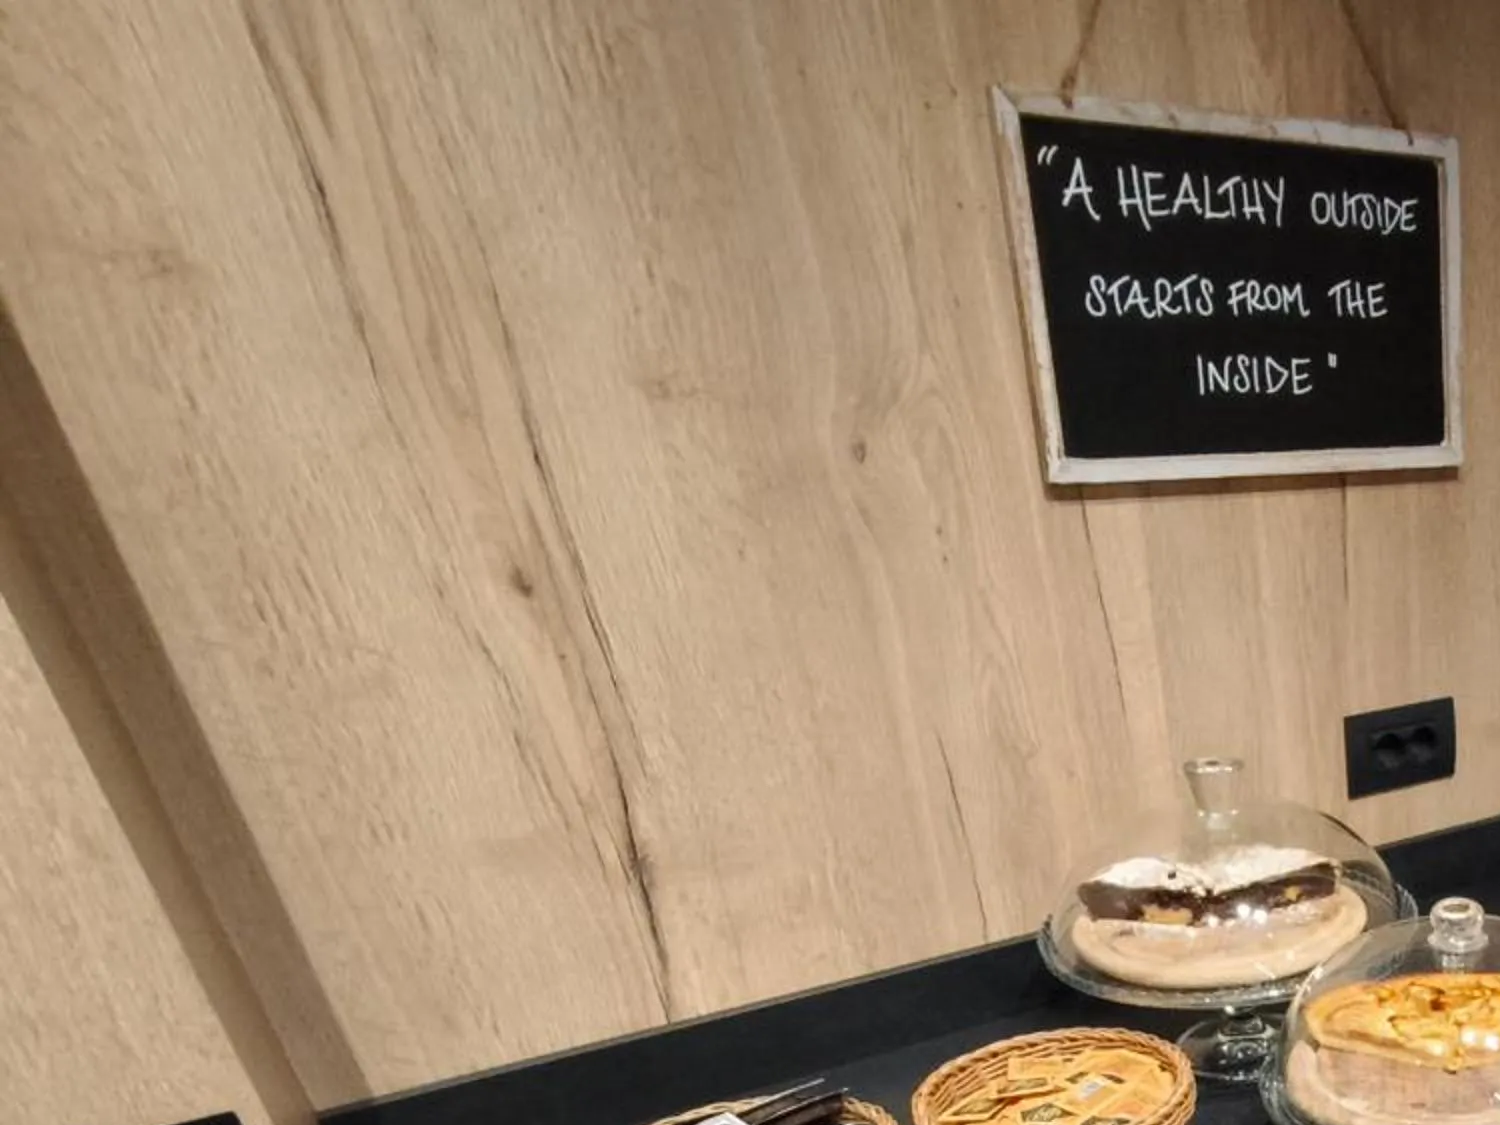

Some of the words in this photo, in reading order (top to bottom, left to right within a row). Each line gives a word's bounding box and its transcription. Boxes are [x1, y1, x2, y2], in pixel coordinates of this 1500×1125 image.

[1116, 164, 1284, 231] HEALTHY
[1310, 190, 1418, 234] OUTSIDE
[1084, 274, 1215, 319] STARTS
[1227, 278, 1310, 319] FROM
[1327, 279, 1388, 319] THE
